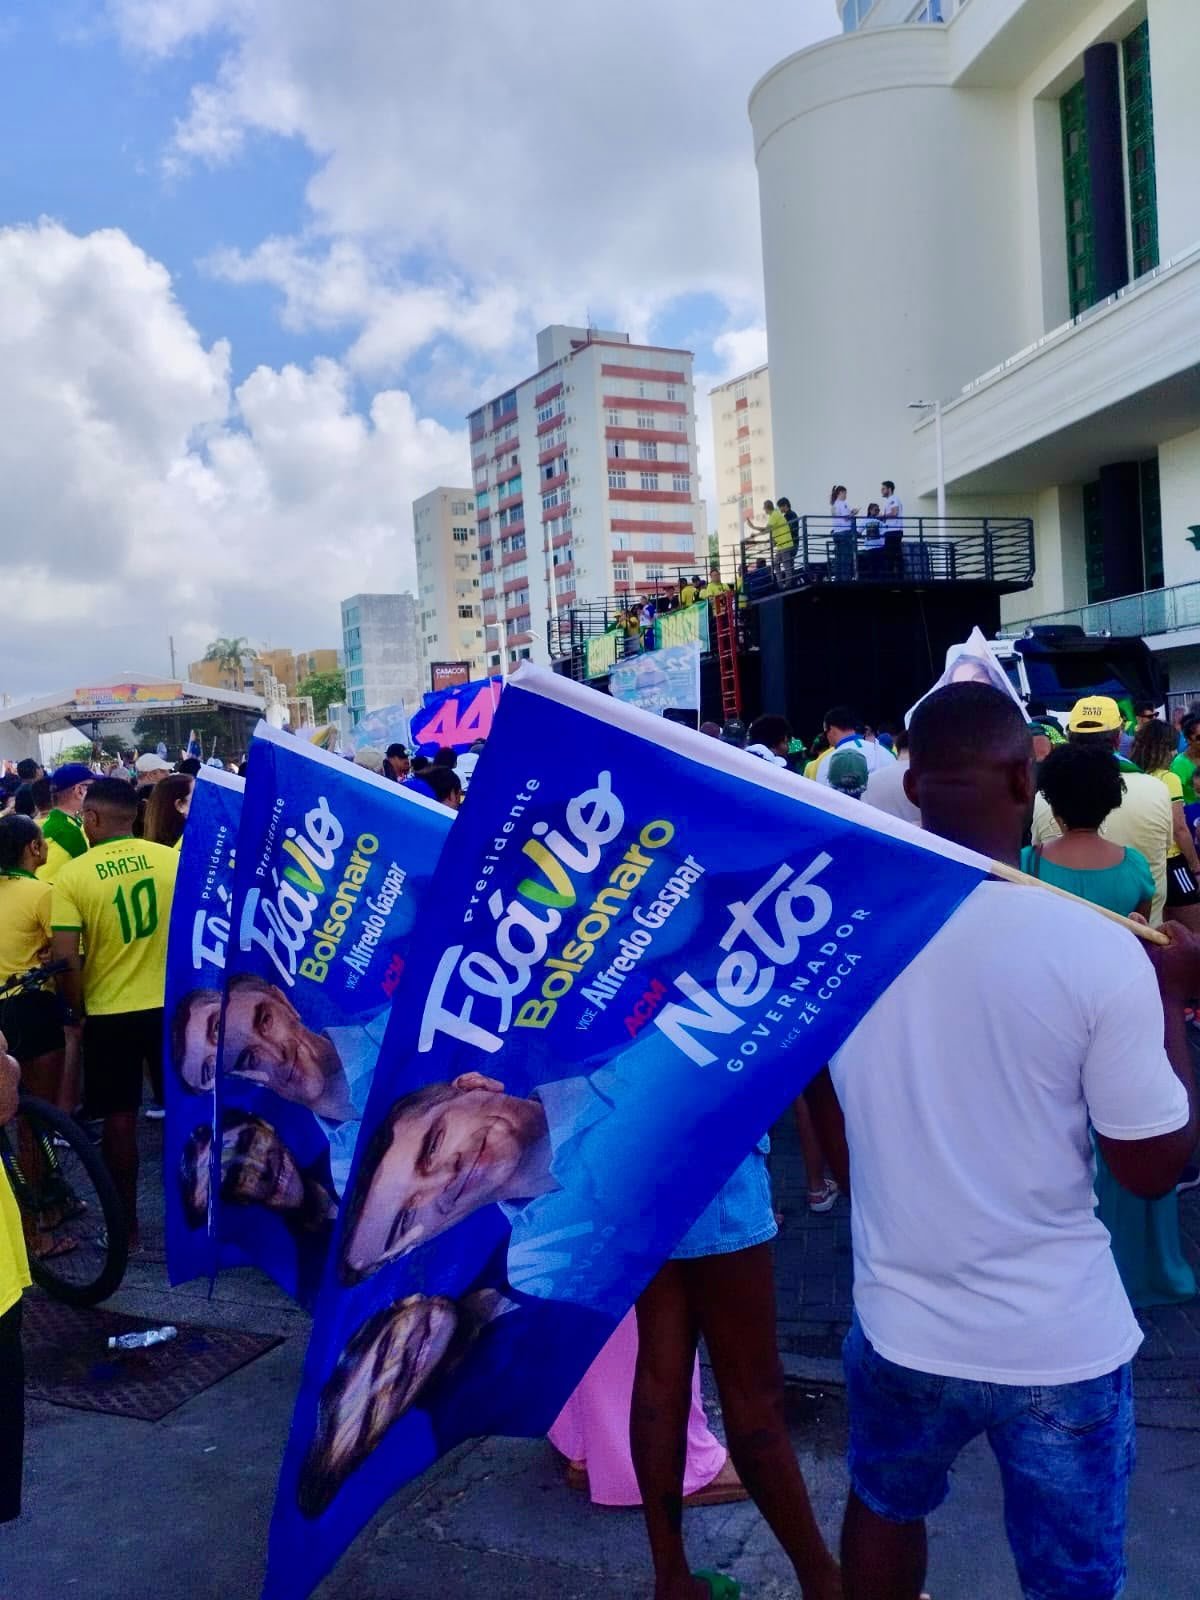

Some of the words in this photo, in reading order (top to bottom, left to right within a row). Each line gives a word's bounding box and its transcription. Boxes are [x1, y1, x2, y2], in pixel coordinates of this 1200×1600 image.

[415, 681, 502, 748] 44
[95, 854, 155, 881] BRASIL
[201, 824, 228, 900] Presidente
[255, 797, 285, 878] Presidente
[463, 776, 541, 924] Presidente
[111, 877, 159, 945] 10
[298, 832, 380, 984] Bolsonaro
[342, 914, 386, 976] Alfredo
[365, 860, 407, 916] Gaspar
[512, 818, 675, 1029] Bolsonaro
[632, 854, 707, 929] Gaspar
[579, 929, 653, 1011] Alfredo
[623, 977, 669, 1039] ACM
[653, 850, 834, 1067] Neto
[726, 908, 871, 1073] GOVERNADOR
[575, 1007, 599, 1031] VICE
[779, 1026, 801, 1049] VICE
[798, 1001, 821, 1025] ZÉ
[817, 952, 862, 1000] COCÁ
